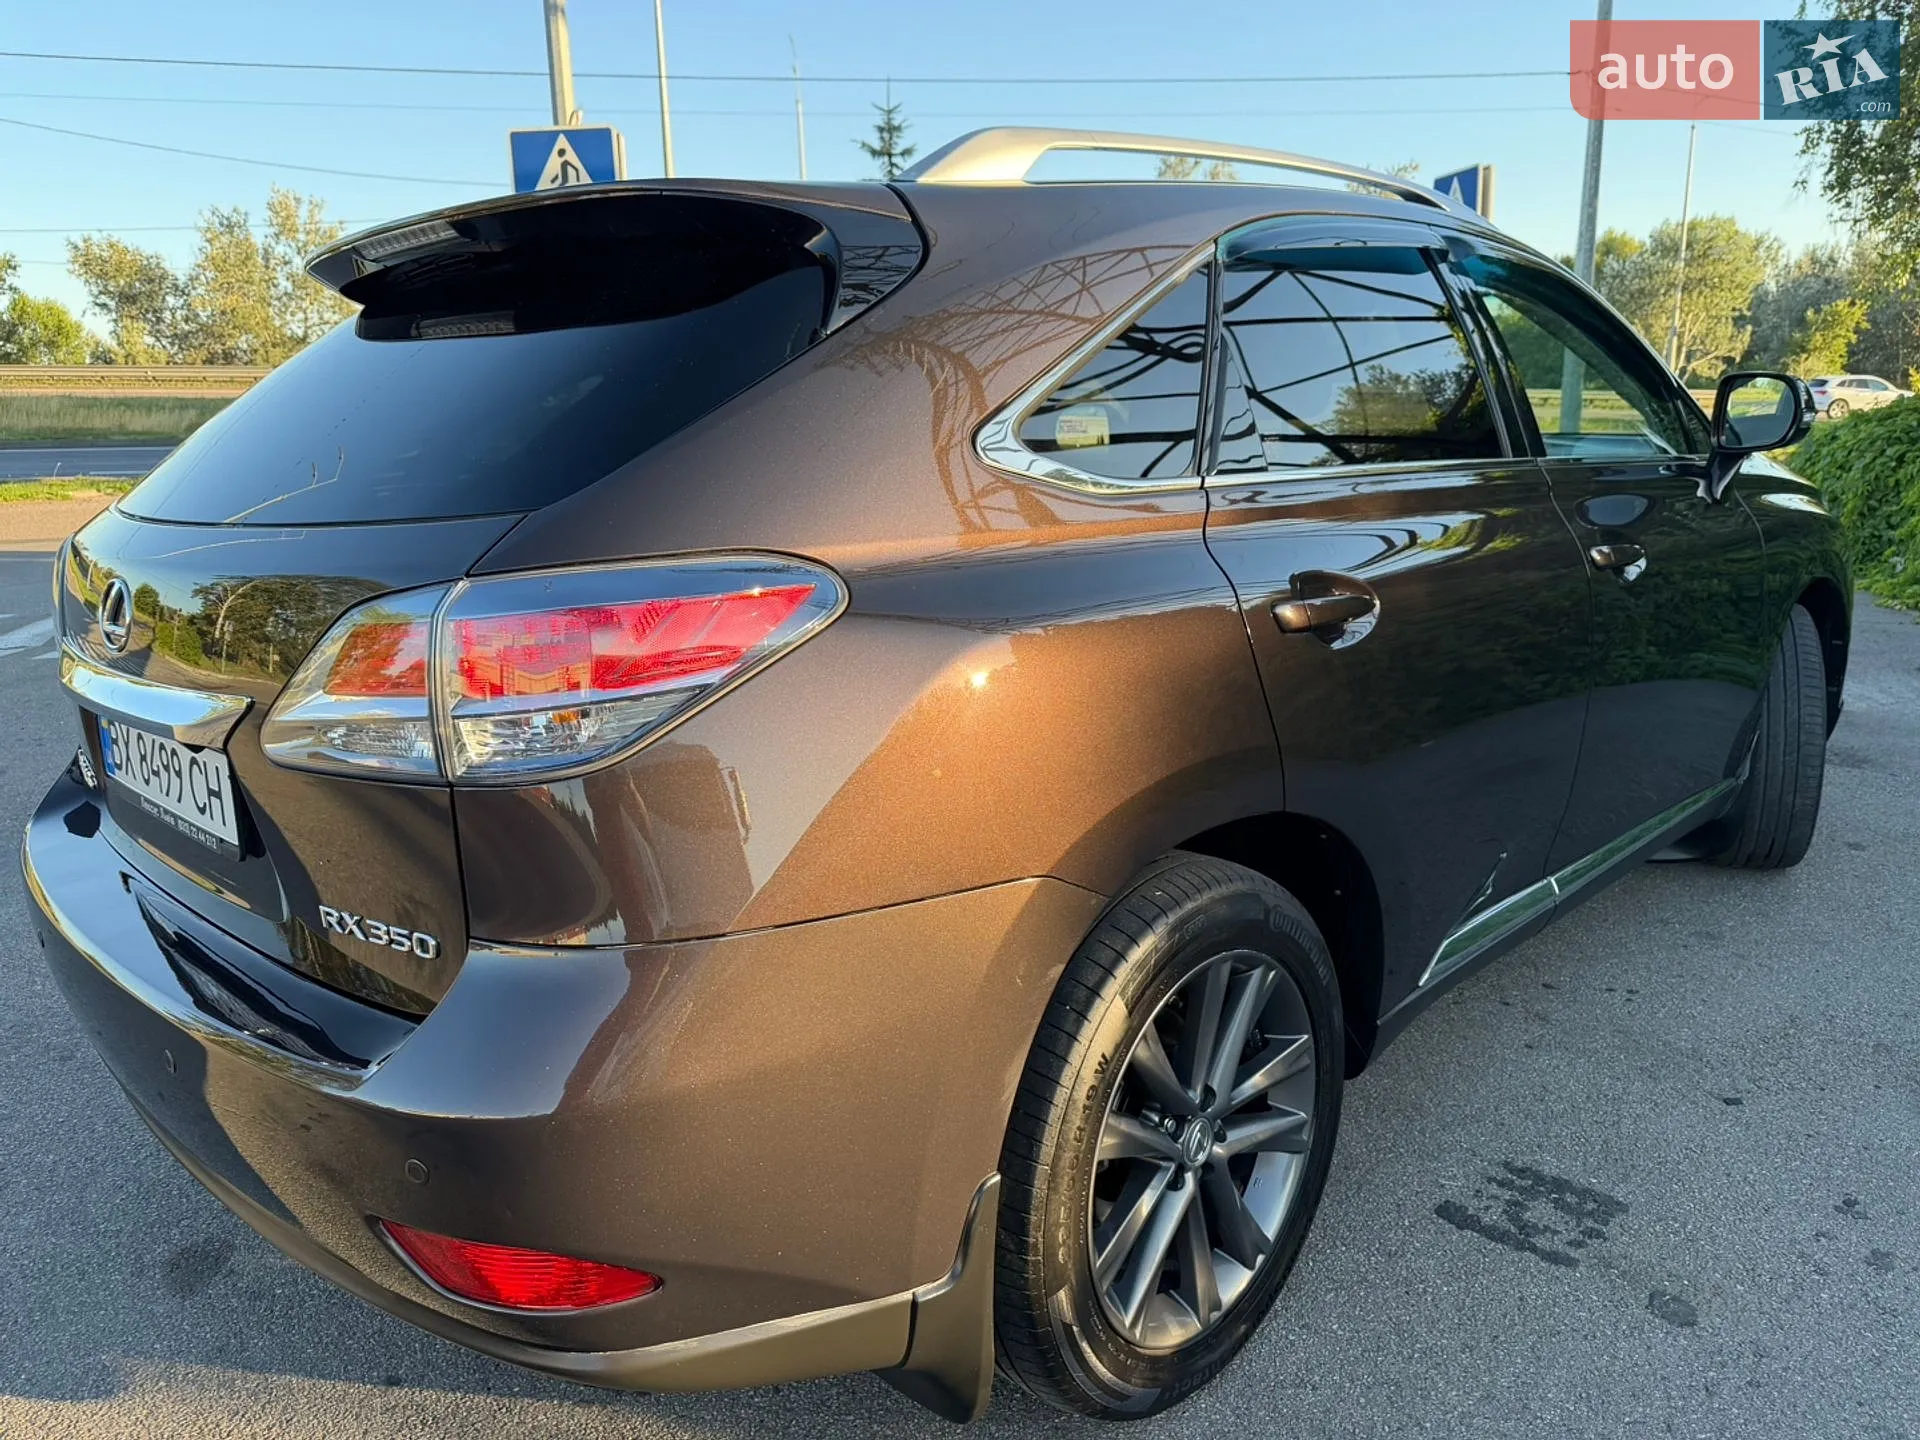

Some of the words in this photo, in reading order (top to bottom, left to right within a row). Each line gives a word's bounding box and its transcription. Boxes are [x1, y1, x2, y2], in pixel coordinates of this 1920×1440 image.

[110, 720, 136, 780] BX
[137, 731, 183, 804] 8499
[189, 756, 227, 828] CH
